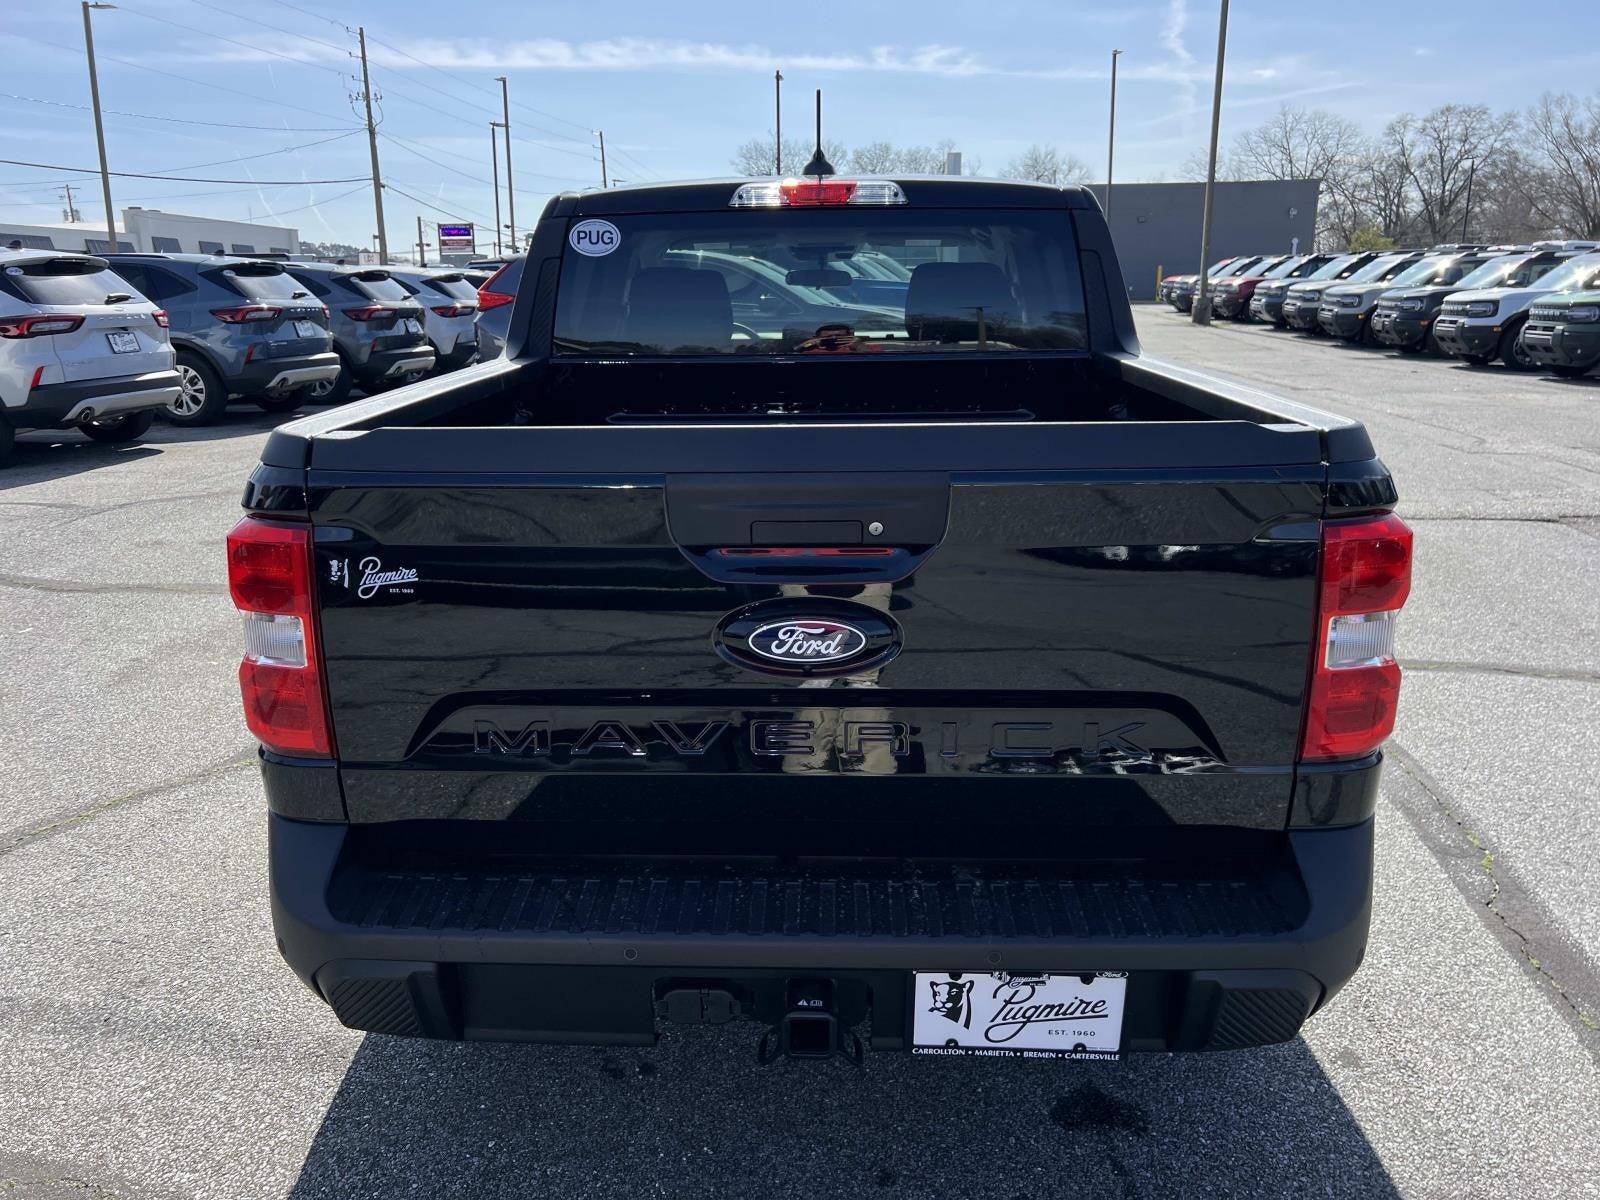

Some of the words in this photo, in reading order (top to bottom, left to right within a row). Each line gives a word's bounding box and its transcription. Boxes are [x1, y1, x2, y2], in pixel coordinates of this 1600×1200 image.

[576, 230, 614, 246] PUG
[358, 556, 419, 599] Pugmire
[770, 625, 843, 655] Ford
[473, 719, 1150, 758] MAVERICK
[984, 980, 1109, 1043] Pugmire
[911, 1047, 966, 1056] CARROLLTON
[974, 1049, 1015, 1057] MARIETTA
[1023, 1051, 1057, 1059] BREMEN
[1064, 1052, 1121, 1061] CARTERSVILLE
